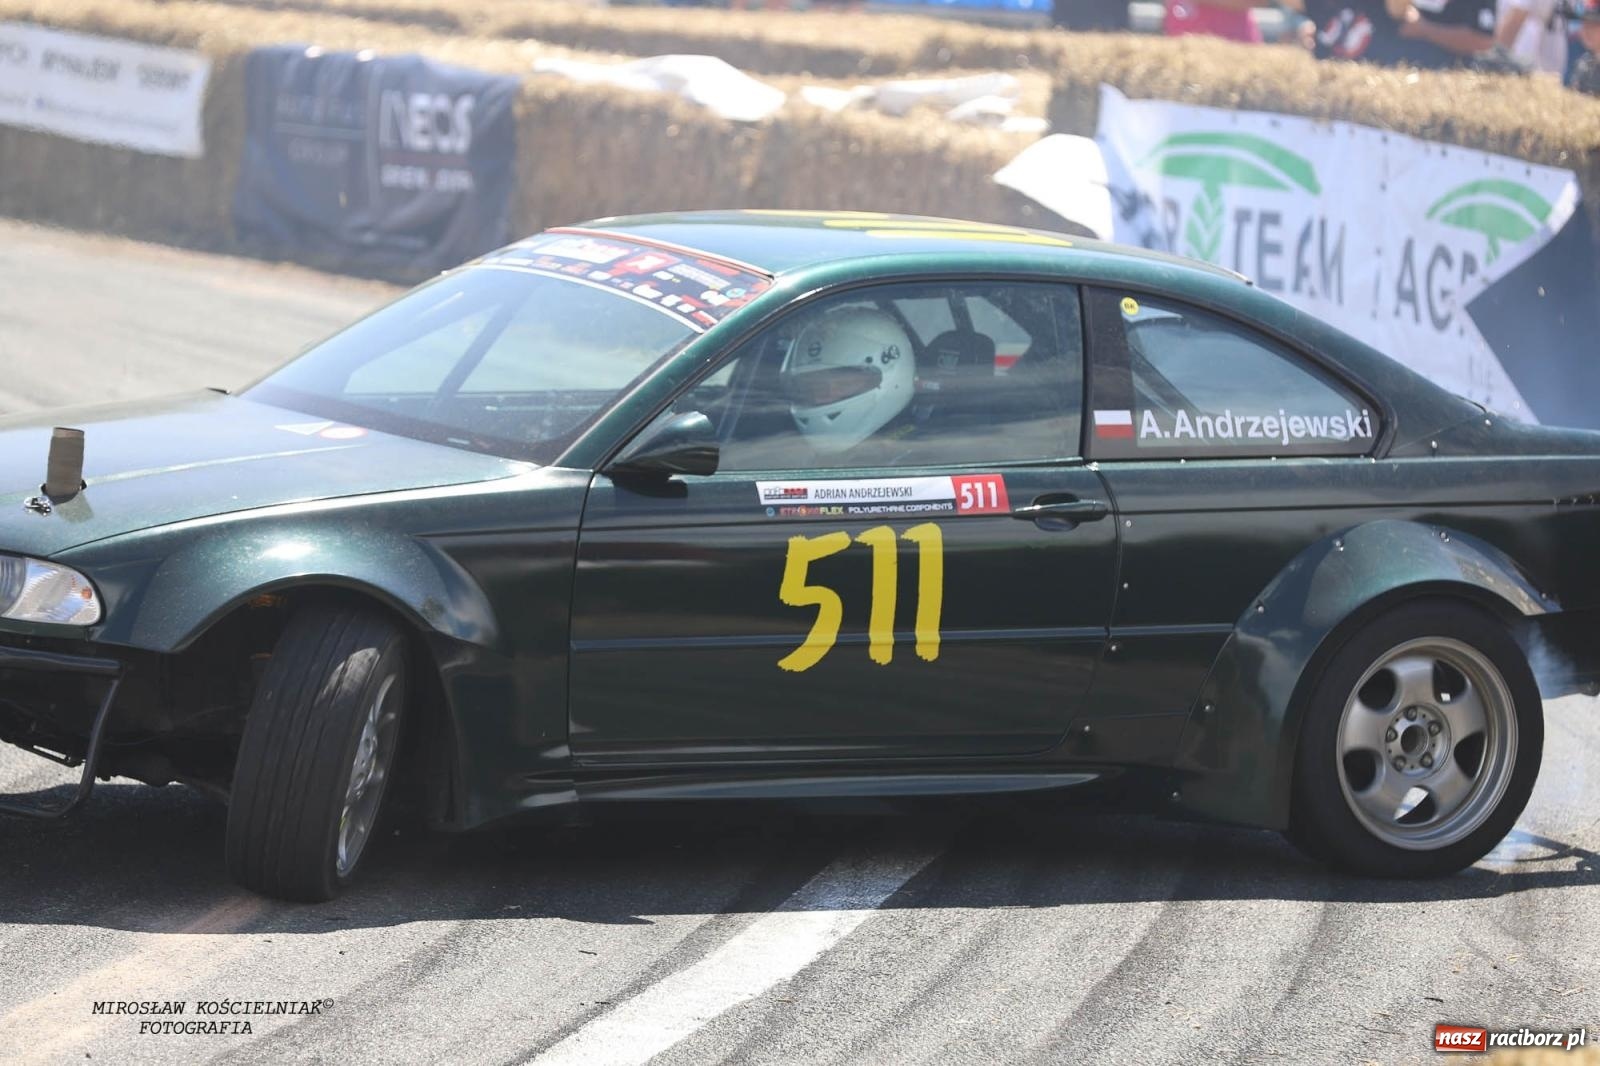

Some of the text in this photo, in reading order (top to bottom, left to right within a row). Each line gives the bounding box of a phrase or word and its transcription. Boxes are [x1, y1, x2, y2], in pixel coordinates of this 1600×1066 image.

[1140, 409, 1373, 446] A.Andrzejewski
[814, 487, 847, 500] ADRIAN
[849, 486, 913, 499] ANDRZEJEWSKI
[960, 481, 998, 510] 511
[848, 504, 905, 515] POLYURETHANE
[905, 502, 953, 512] COMPONENTS
[777, 522, 944, 673] 511
